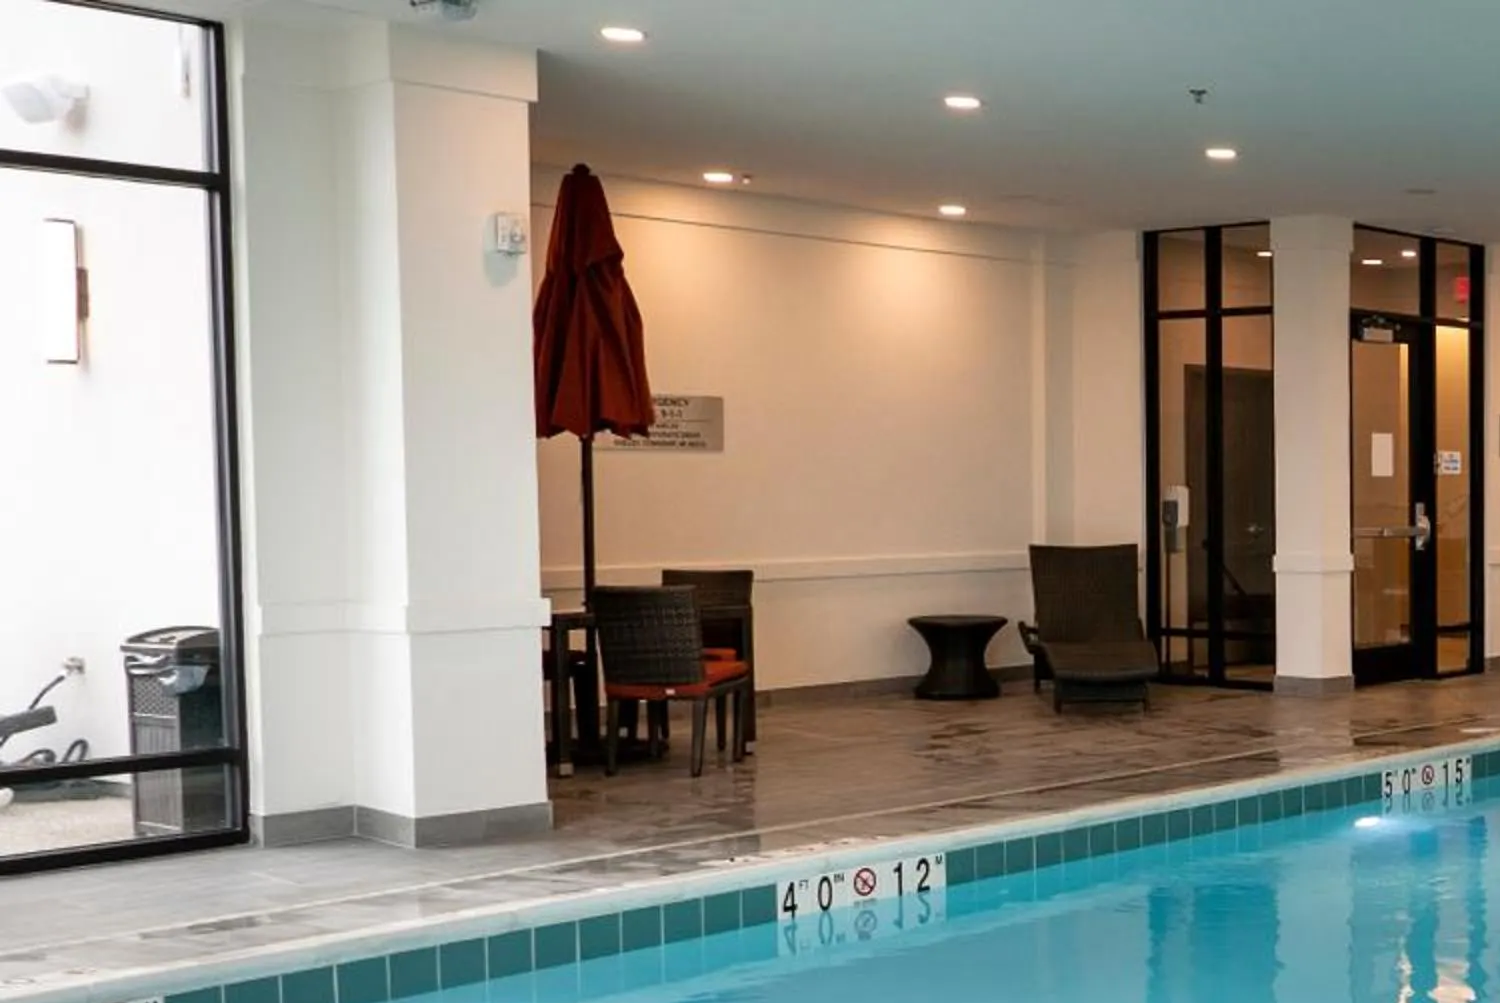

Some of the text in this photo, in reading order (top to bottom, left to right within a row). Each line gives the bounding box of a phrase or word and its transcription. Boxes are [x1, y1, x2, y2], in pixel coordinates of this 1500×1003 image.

[1384, 772, 1393, 798] 5
[783, 881, 797, 919] 4
[817, 876, 833, 911] 0
